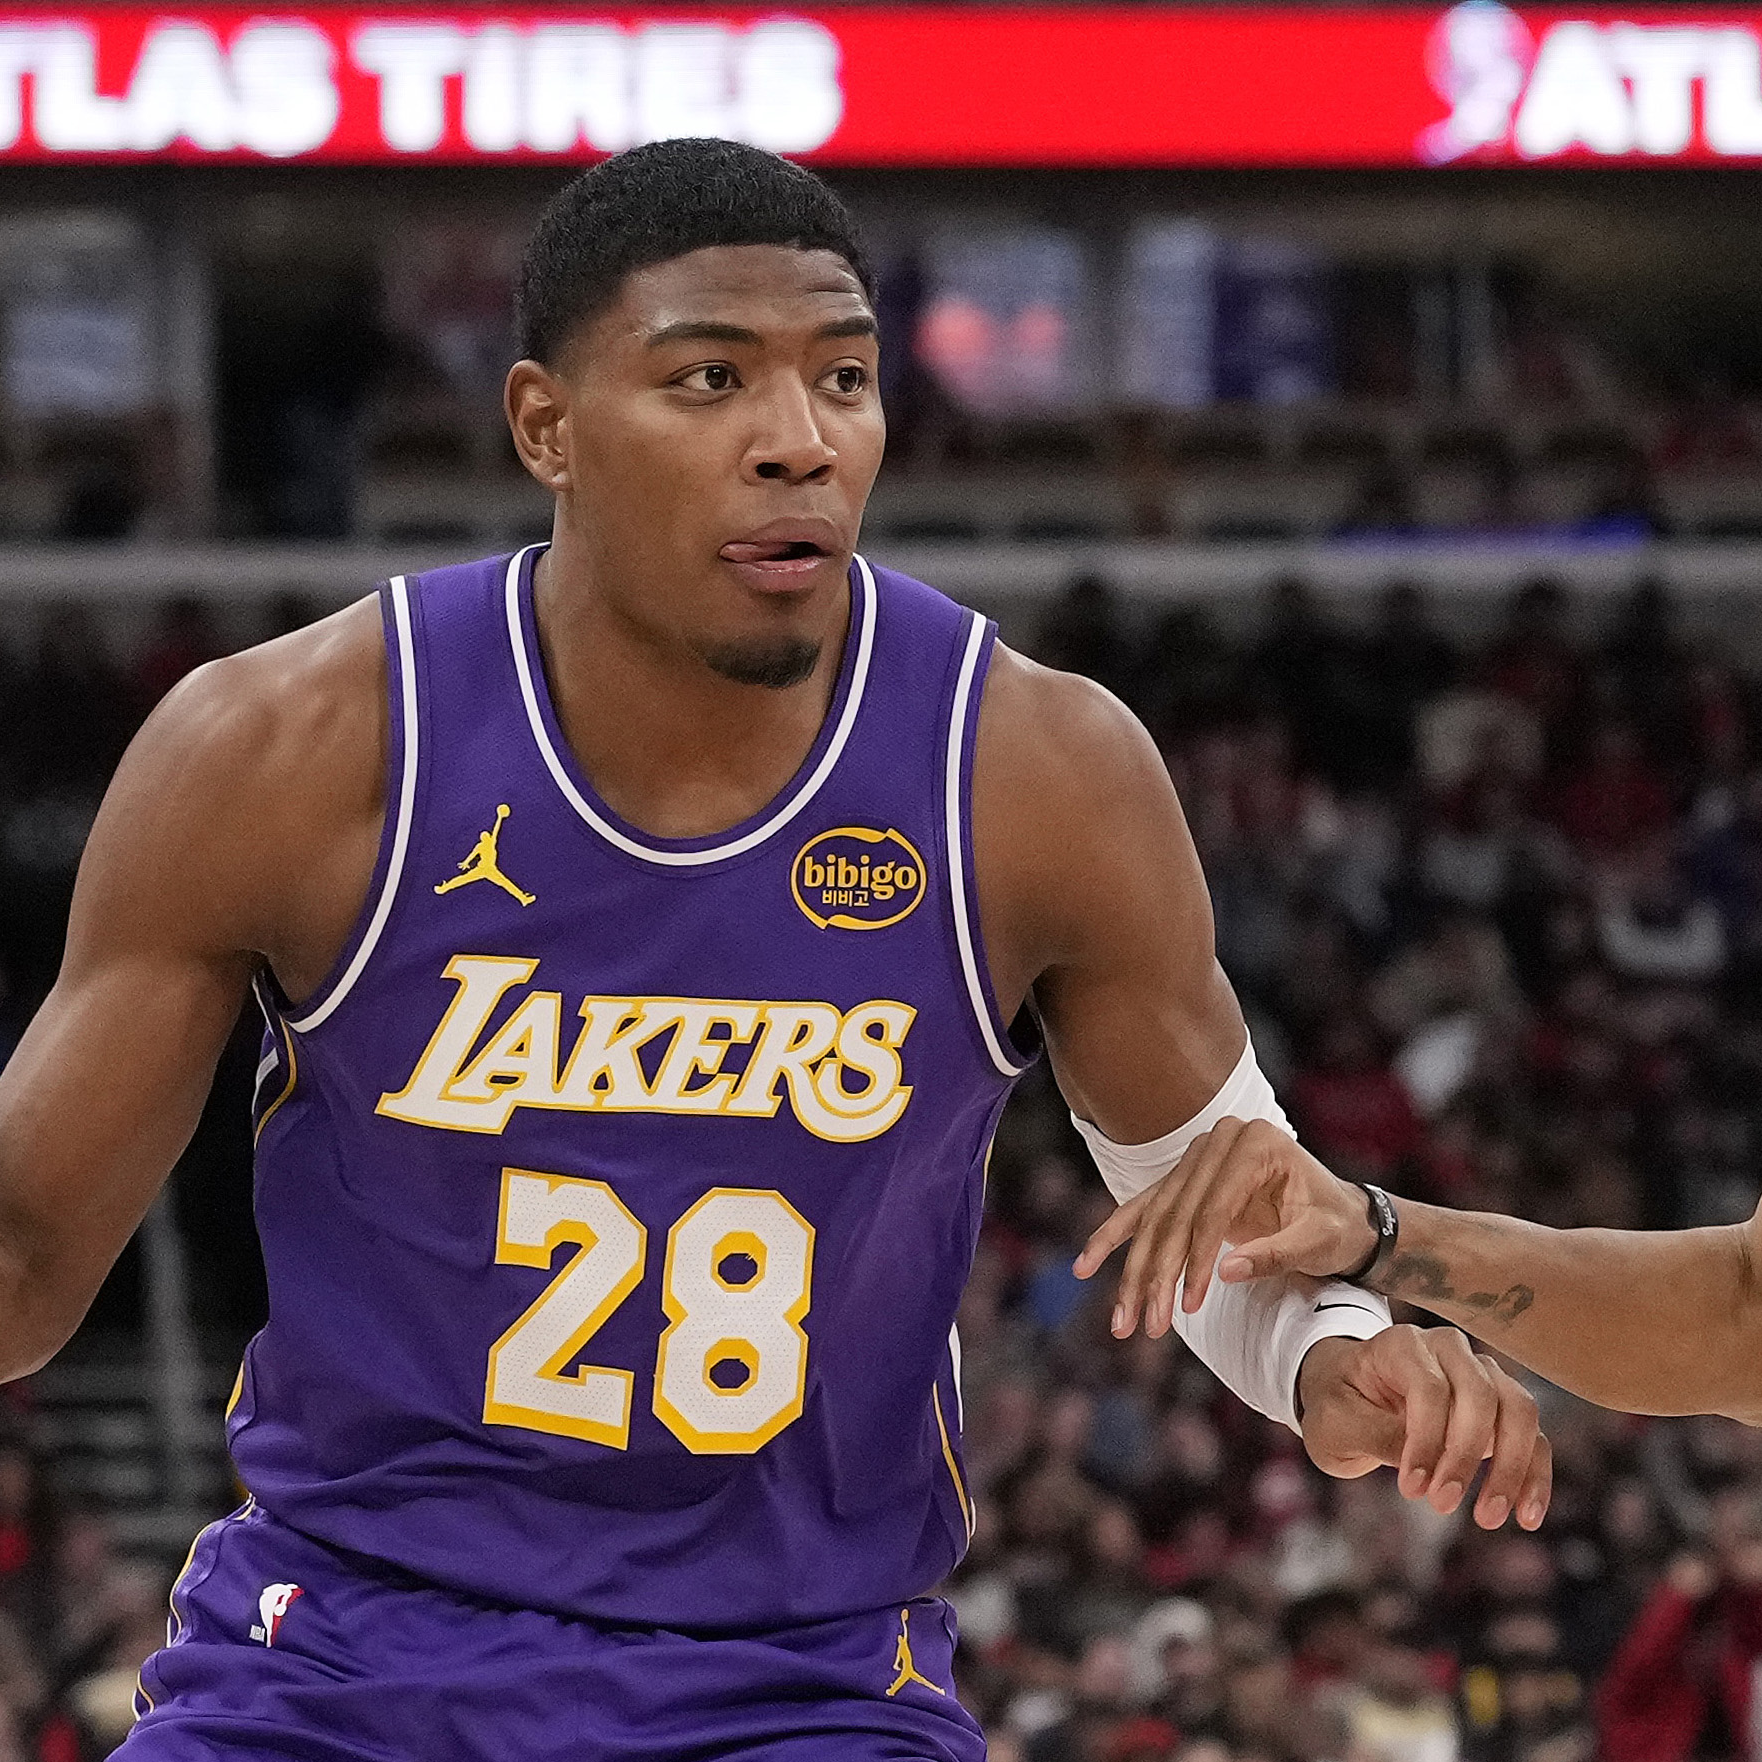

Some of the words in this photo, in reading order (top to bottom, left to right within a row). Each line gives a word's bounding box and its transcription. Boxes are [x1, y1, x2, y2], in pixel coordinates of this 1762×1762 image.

[349, 14, 845, 154] TIRES
[803, 853, 918, 900] bibigo
[822, 889, 870, 907] 비비고
[375, 953, 919, 1144] LAKERS
[482, 1166, 817, 1455] 28
